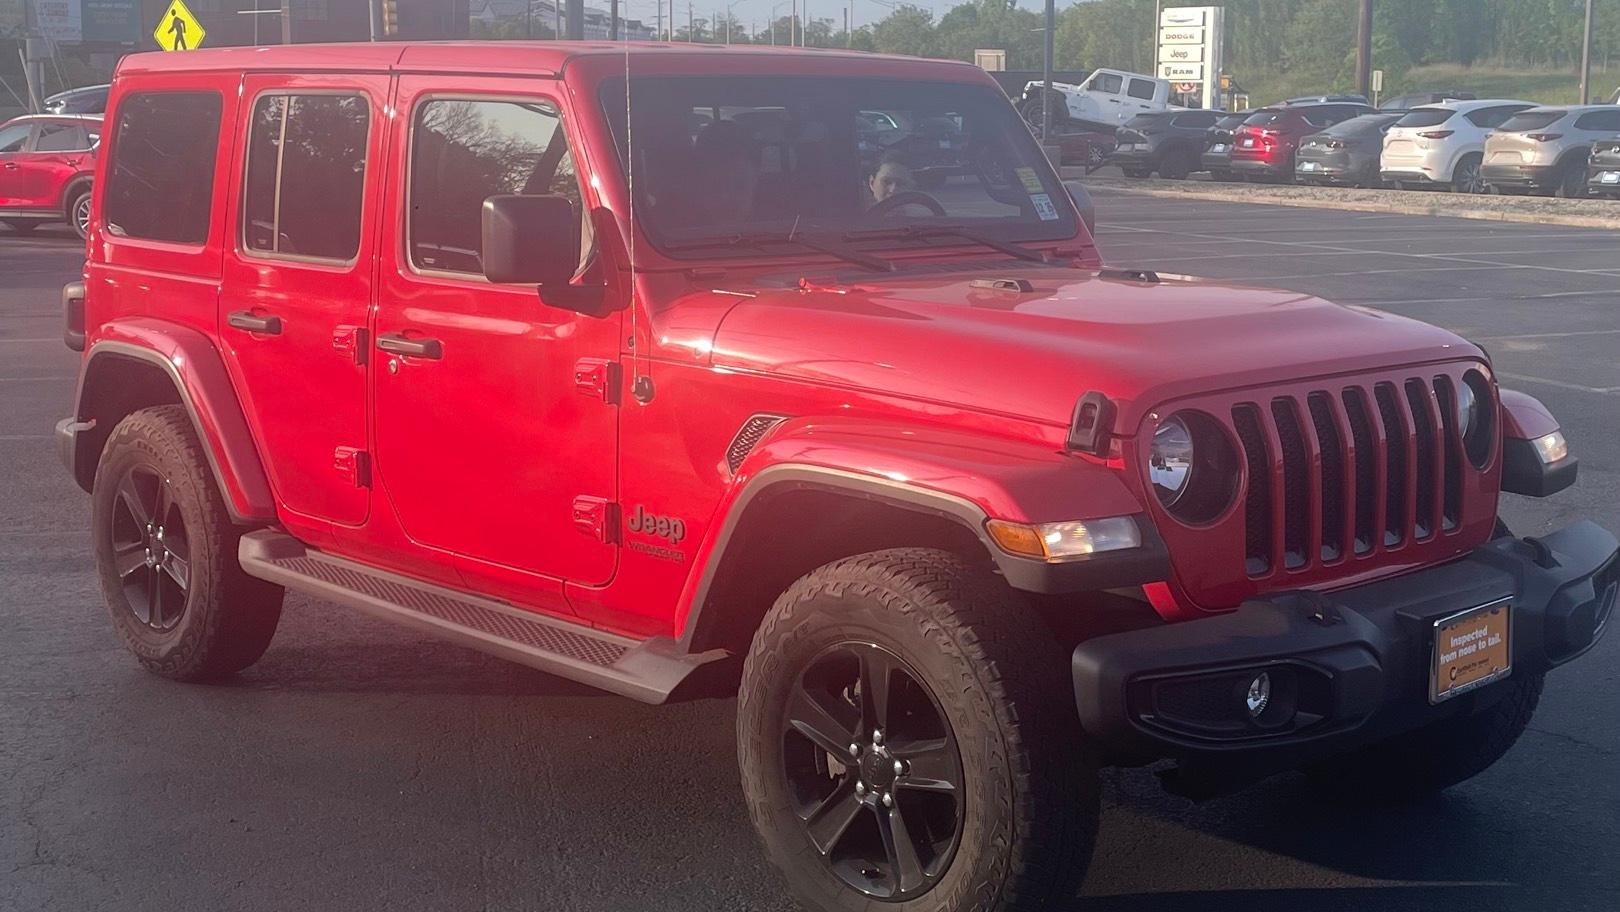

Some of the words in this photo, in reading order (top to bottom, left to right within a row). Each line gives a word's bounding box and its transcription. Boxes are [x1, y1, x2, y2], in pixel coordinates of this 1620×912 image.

[1170, 49, 1189, 59] Jeep
[628, 504, 686, 545] Jeep
[1450, 625, 1488, 648] Inspected
[1440, 650, 1457, 665] from
[1458, 644, 1477, 658] nose
[1478, 638, 1487, 650] to
